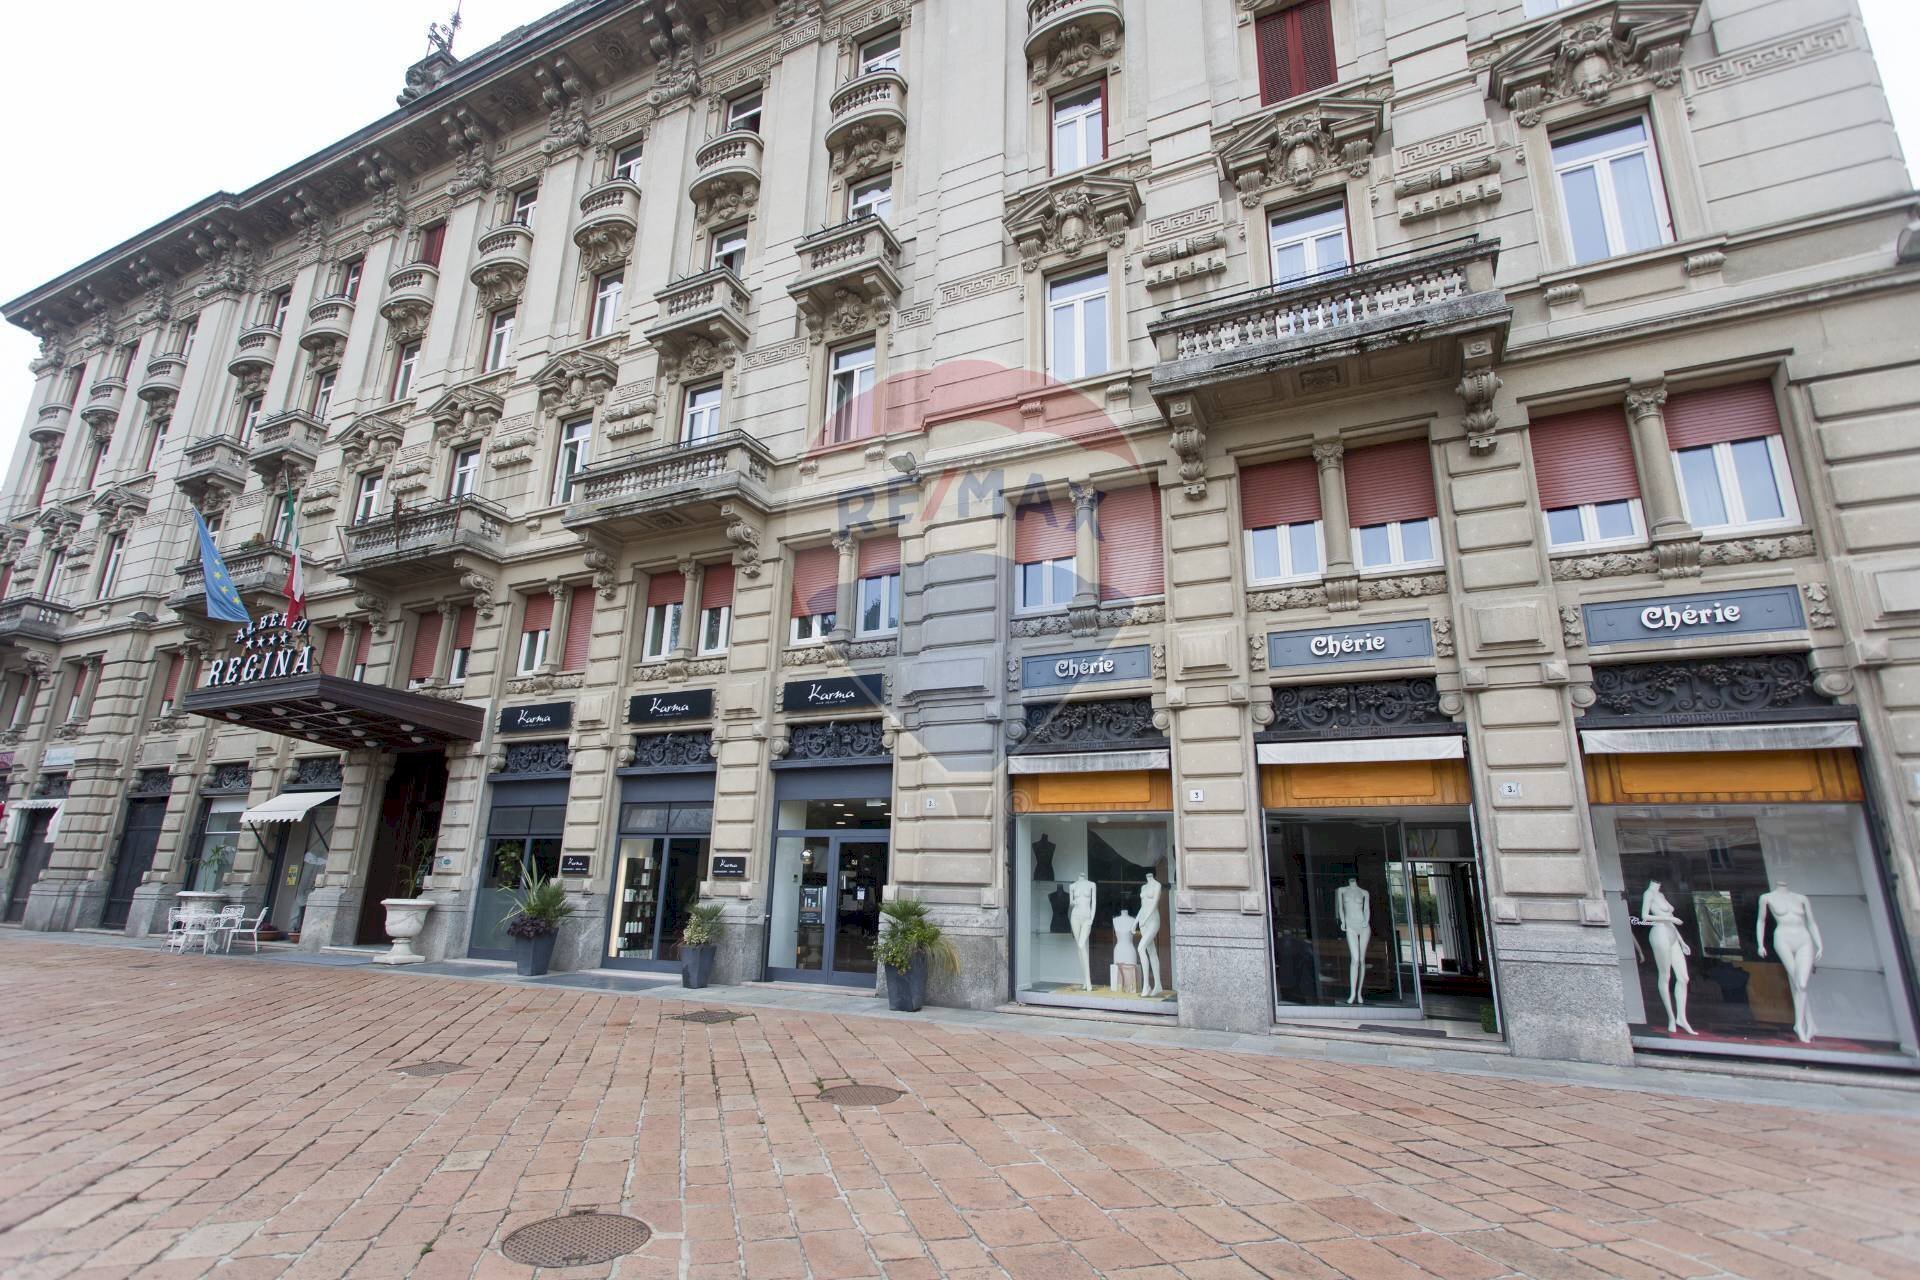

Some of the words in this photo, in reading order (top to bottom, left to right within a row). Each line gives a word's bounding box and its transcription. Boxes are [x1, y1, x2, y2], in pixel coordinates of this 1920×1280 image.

[1641, 602, 1741, 630] Chérie
[1311, 632, 1385, 657] Chérie
[206, 645, 311, 686] REGINA
[1055, 656, 1114, 678] Chérie
[808, 684, 855, 702] Karma
[517, 709, 551, 724] Karma
[650, 697, 689, 714] Karma
